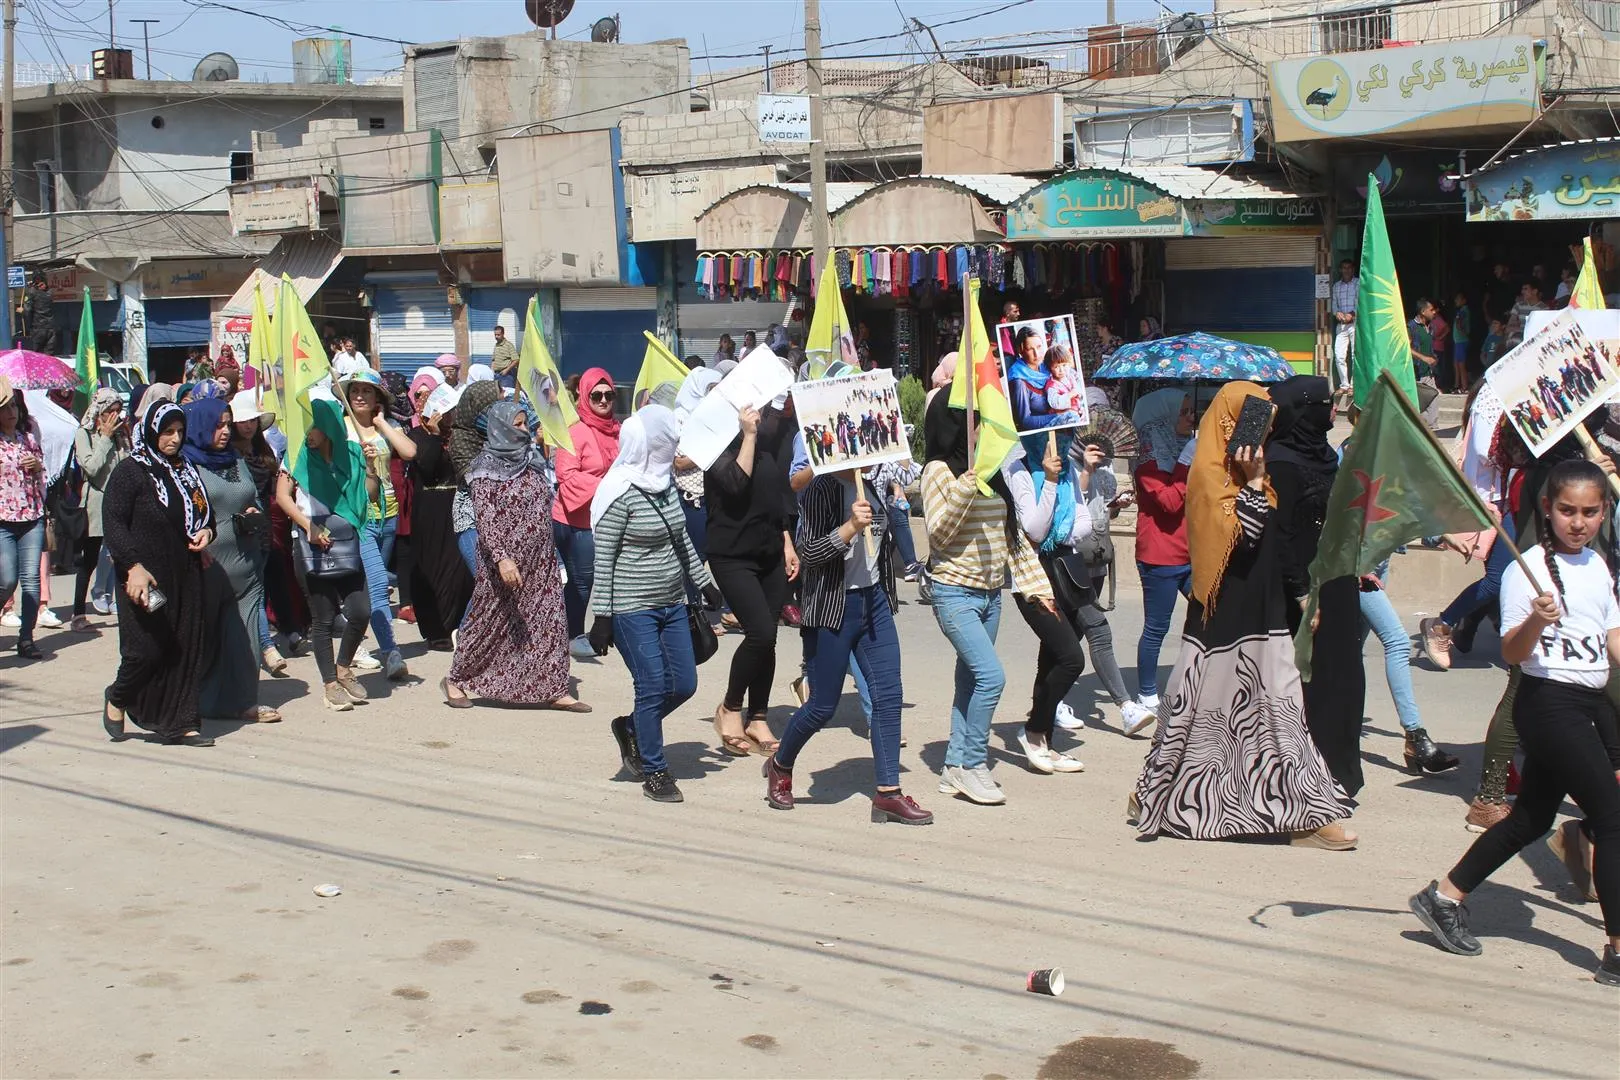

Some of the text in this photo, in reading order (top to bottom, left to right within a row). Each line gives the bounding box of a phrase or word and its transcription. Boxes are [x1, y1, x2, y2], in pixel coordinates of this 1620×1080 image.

[1356, 44, 1530, 103] قيصرية كركي لكي
[766, 131, 805, 139] AVOCAT
[1056, 182, 1135, 224] الشيخ
